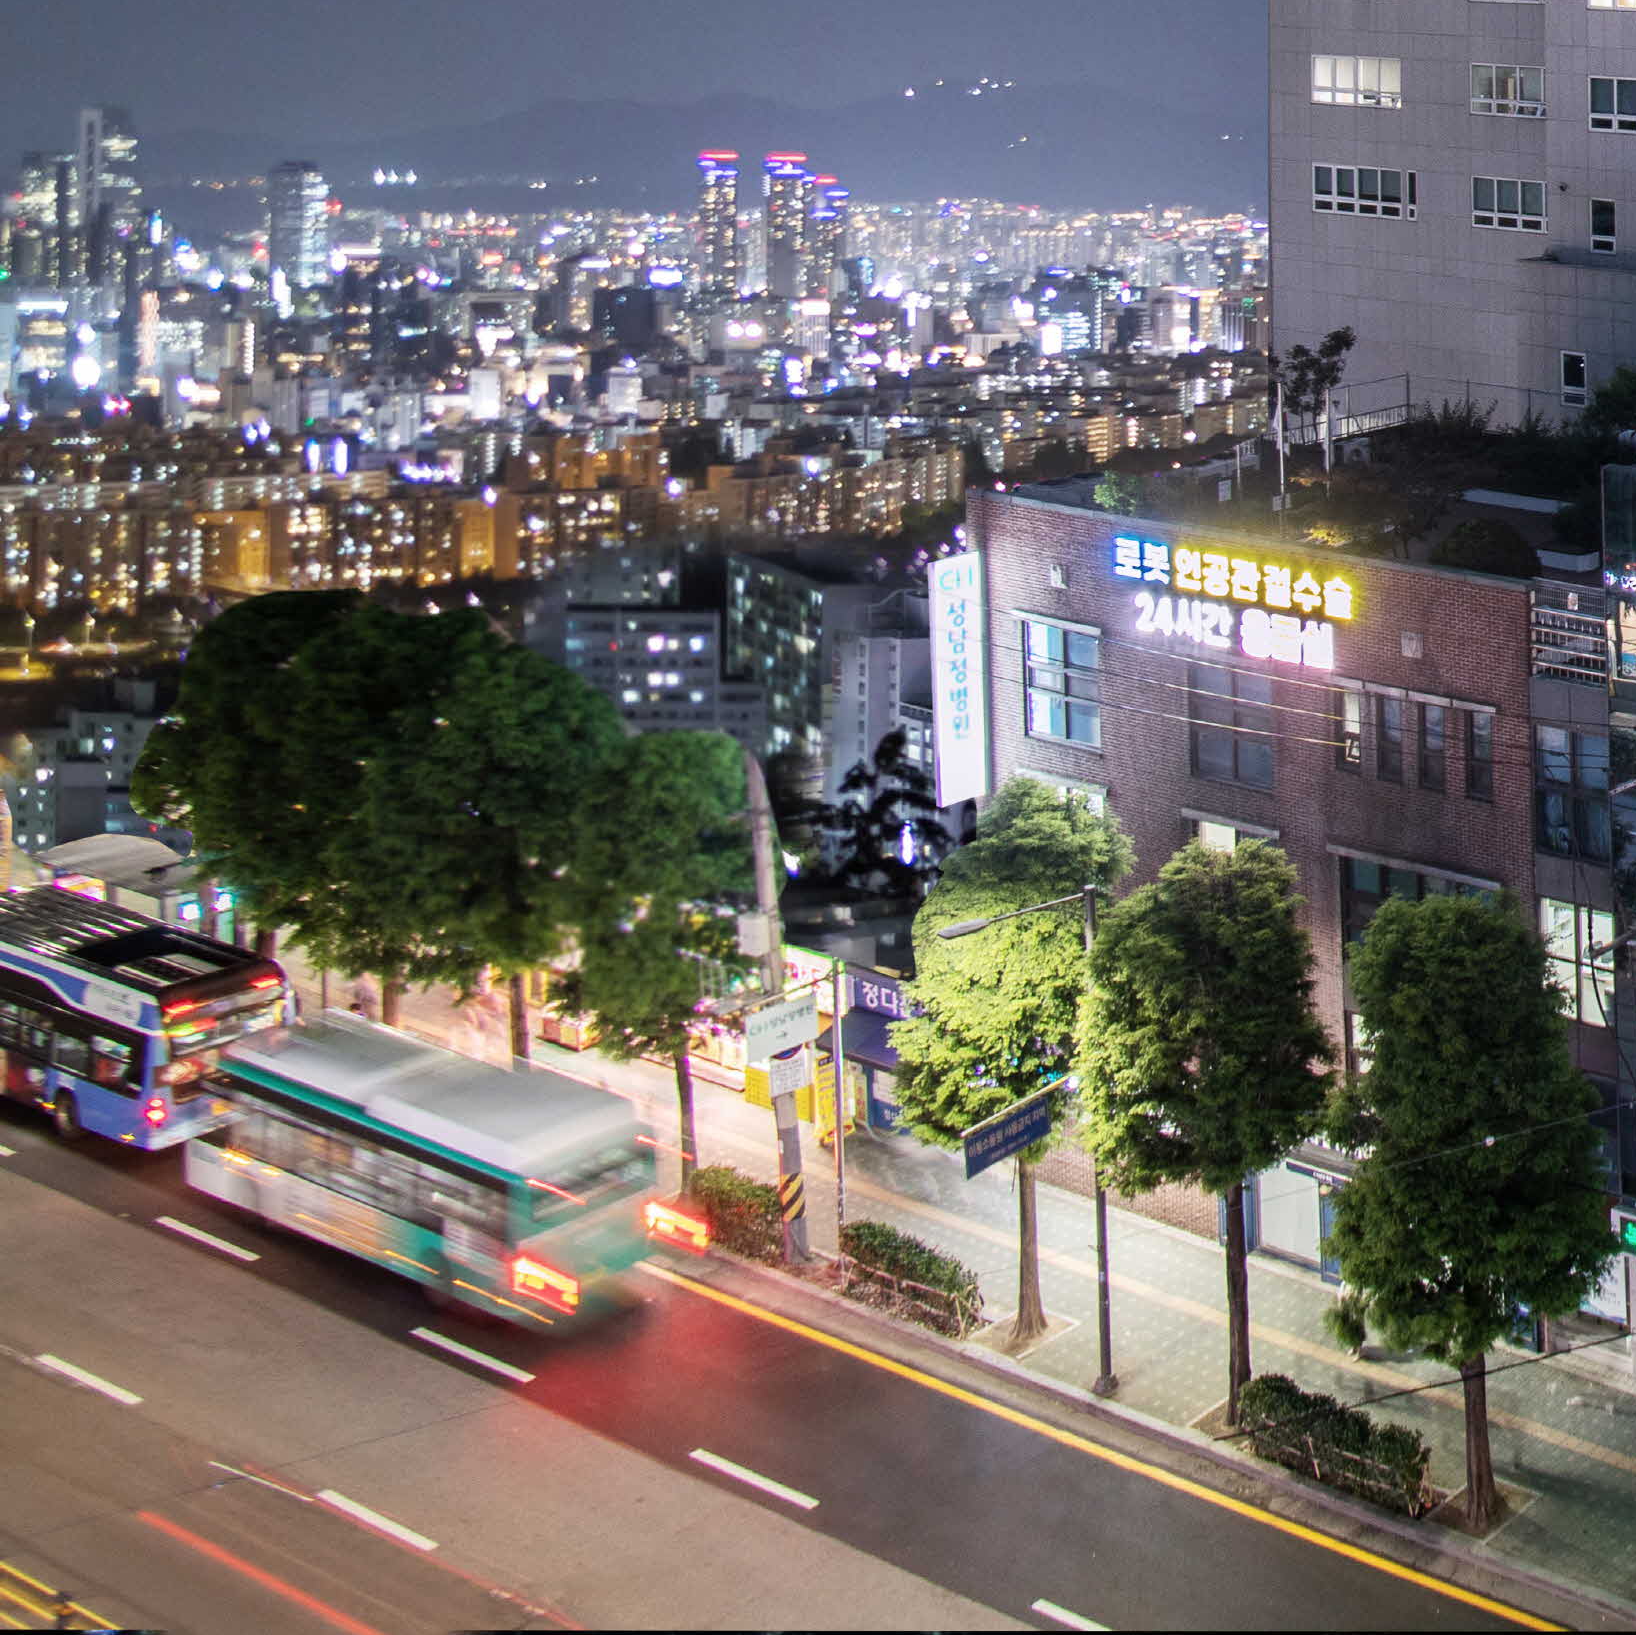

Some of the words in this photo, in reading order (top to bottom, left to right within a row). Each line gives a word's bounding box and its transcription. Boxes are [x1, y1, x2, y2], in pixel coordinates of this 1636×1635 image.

[1114, 537, 1171, 585] 로봇
[1134, 591, 1233, 649] 24시간
[947, 599, 970, 740] 성남정병원
